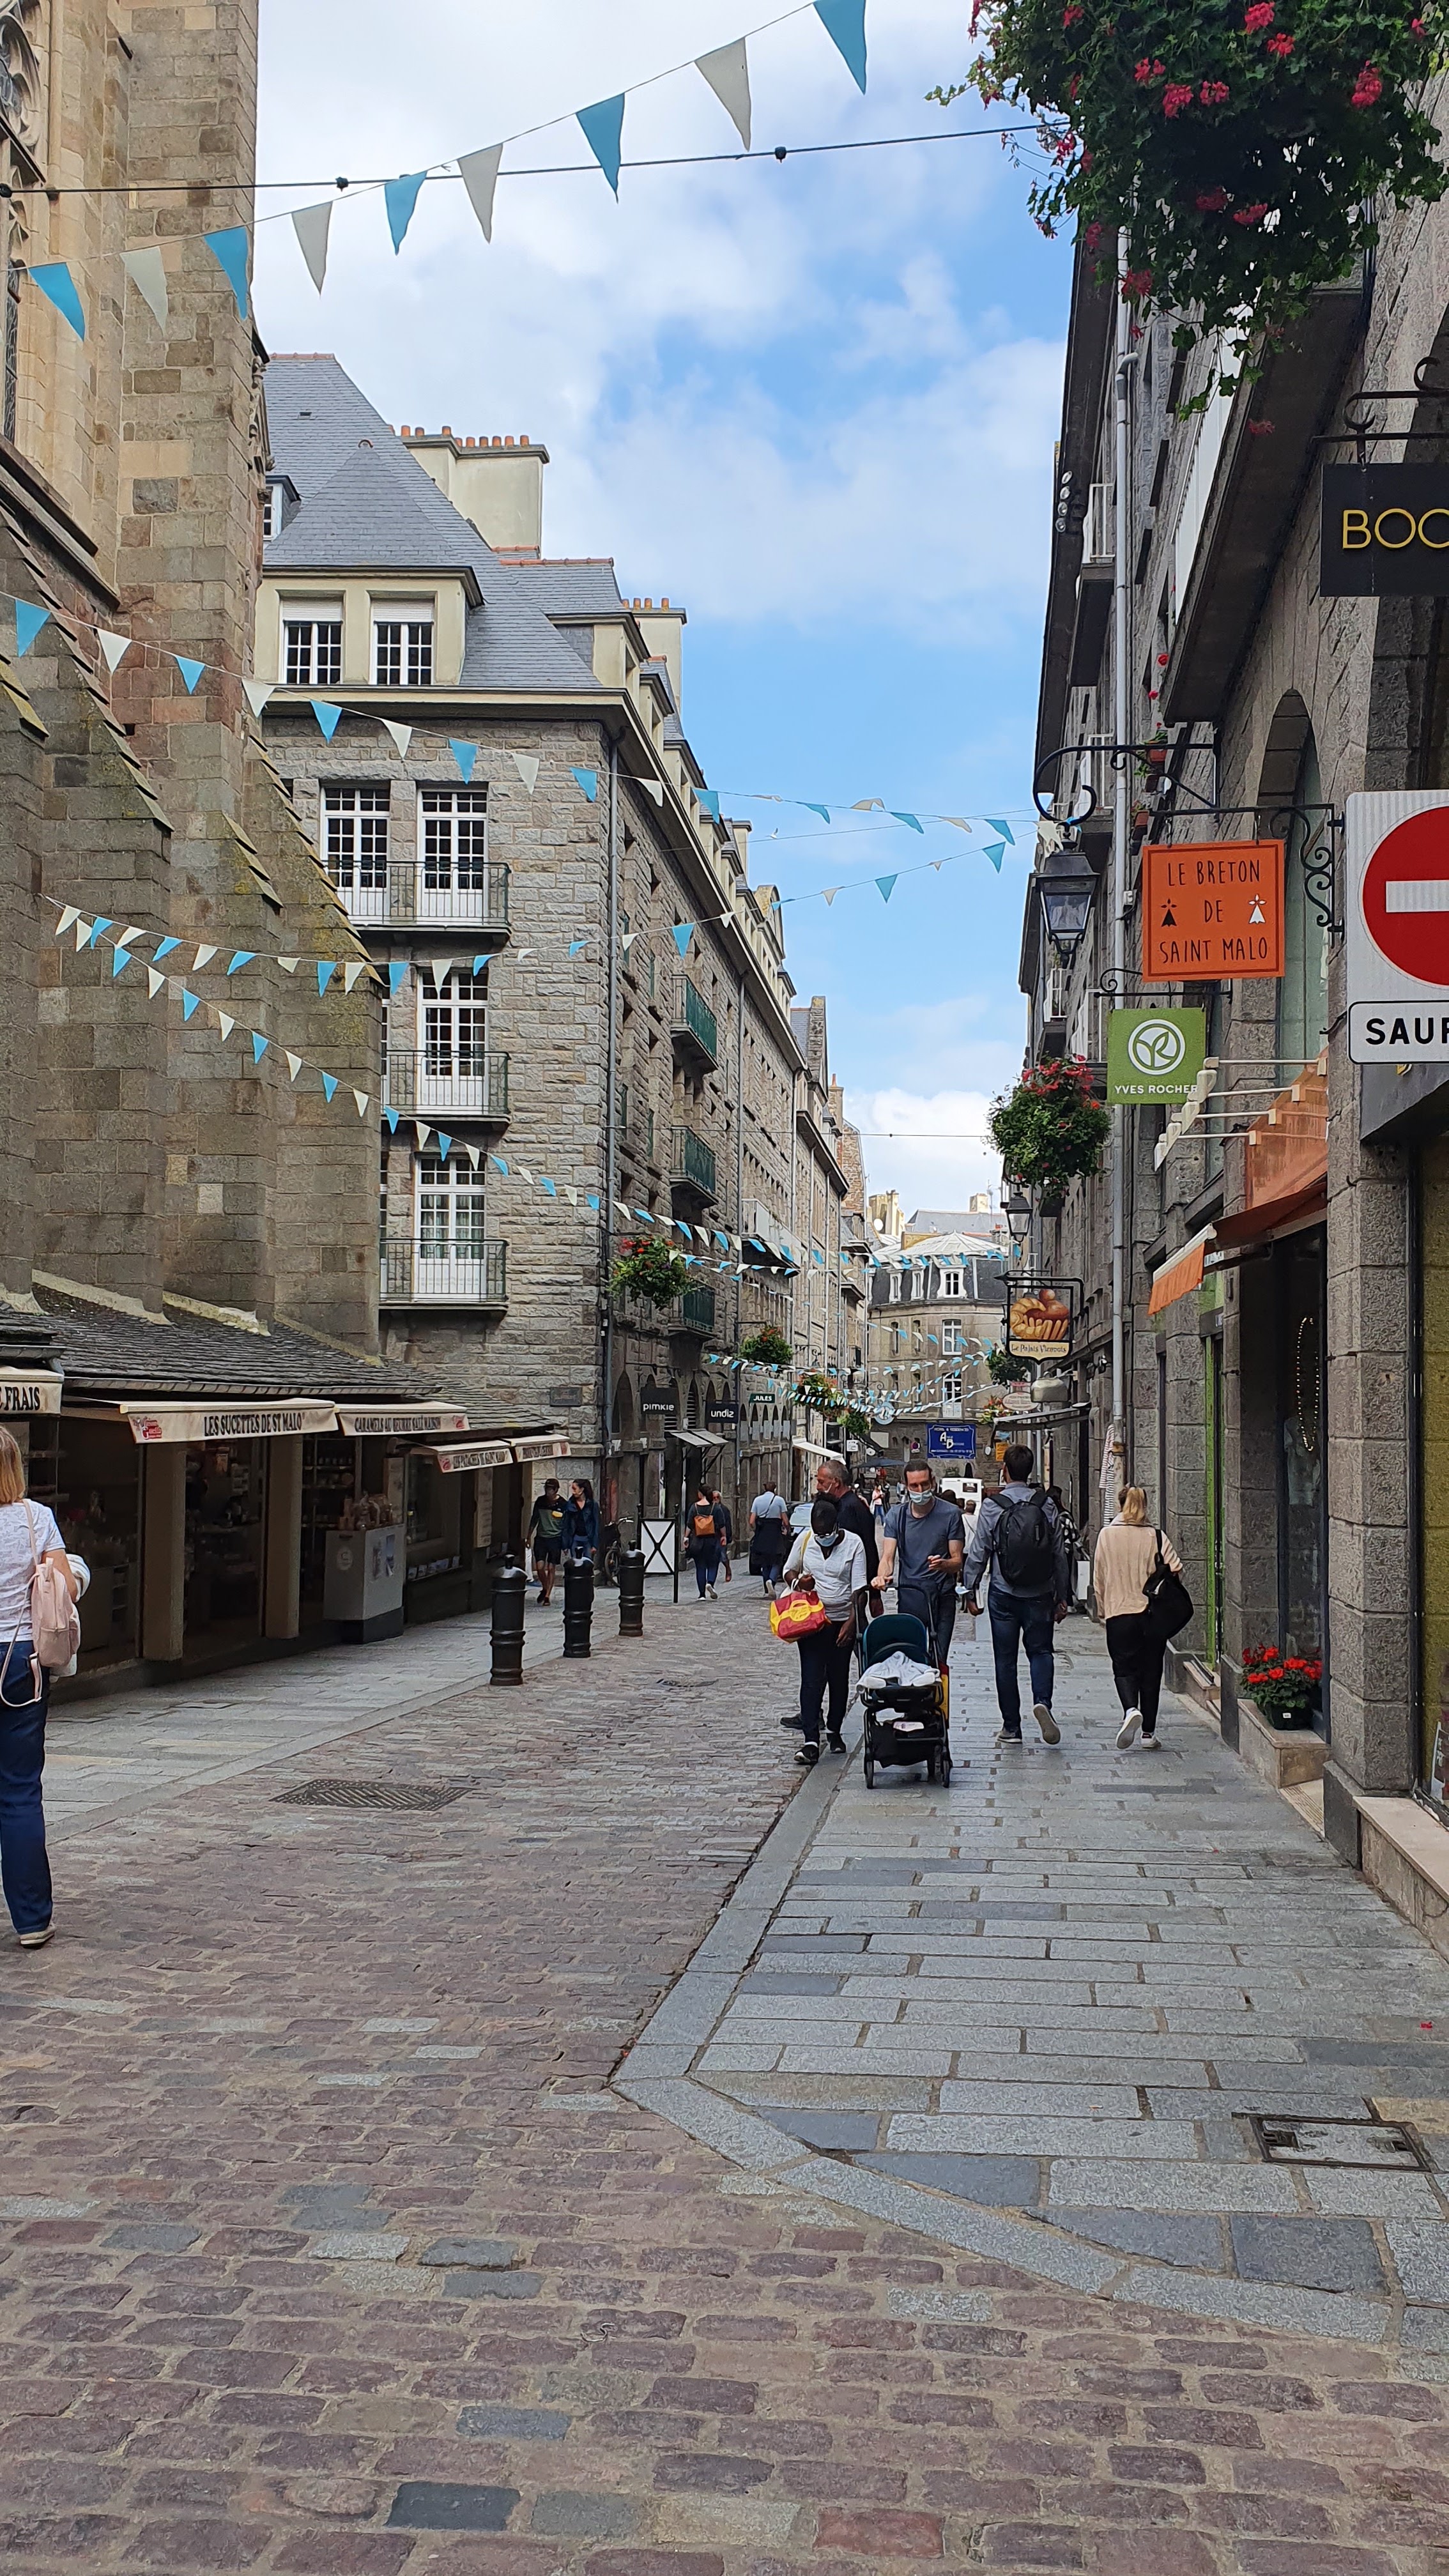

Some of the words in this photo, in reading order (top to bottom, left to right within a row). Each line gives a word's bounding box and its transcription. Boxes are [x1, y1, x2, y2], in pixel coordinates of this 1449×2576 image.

[1168, 862, 1185, 886] LE
[1197, 859, 1260, 885] BRETON
[1204, 900, 1223, 923] DE
[1160, 940, 1211, 963] SAINT
[1222, 937, 1268, 960] MALO
[1115, 1085, 1144, 1094] YVES
[1020, 1344, 1038, 1353] Palais
[4, 1386, 40, 1411] FRAIS
[204, 1416, 218, 1436] LES
[220, 1414, 260, 1435] SUCETTES
[261, 1414, 272, 1433] DE
[272, 1413, 281, 1432] ST
[710, 1409, 734, 1418] undiz
